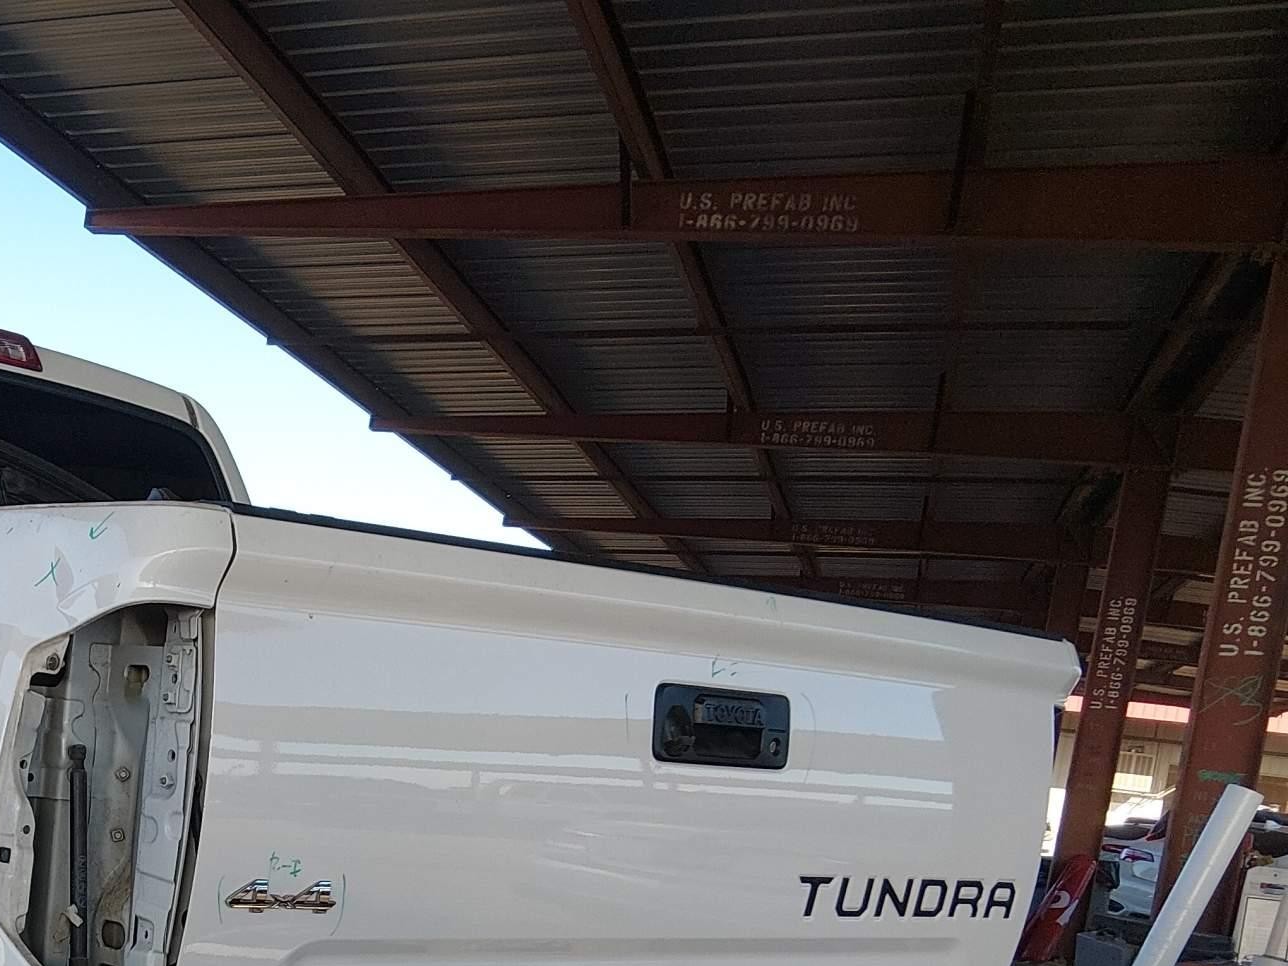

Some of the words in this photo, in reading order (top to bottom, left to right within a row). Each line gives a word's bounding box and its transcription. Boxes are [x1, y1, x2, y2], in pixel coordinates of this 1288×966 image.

[730, 192, 811, 211] PREFAB
[793, 421, 845, 433] PREFAB
[1242, 467, 1268, 508] INC.
[1228, 519, 1259, 604] PREFAB
[1244, 469, 1288, 656] 1-866-799-0969
[1107, 596, 1124, 621] INC.
[1096, 627, 1117, 678] PREFAB
[1105, 598, 1138, 710] 1-866-799-0969
[1219, 617, 1244, 657] U.S.
[704, 703, 763, 727] TOYOTA
[1089, 685, 1108, 710] U.S.
[799, 876, 1016, 918] TUNDRA
